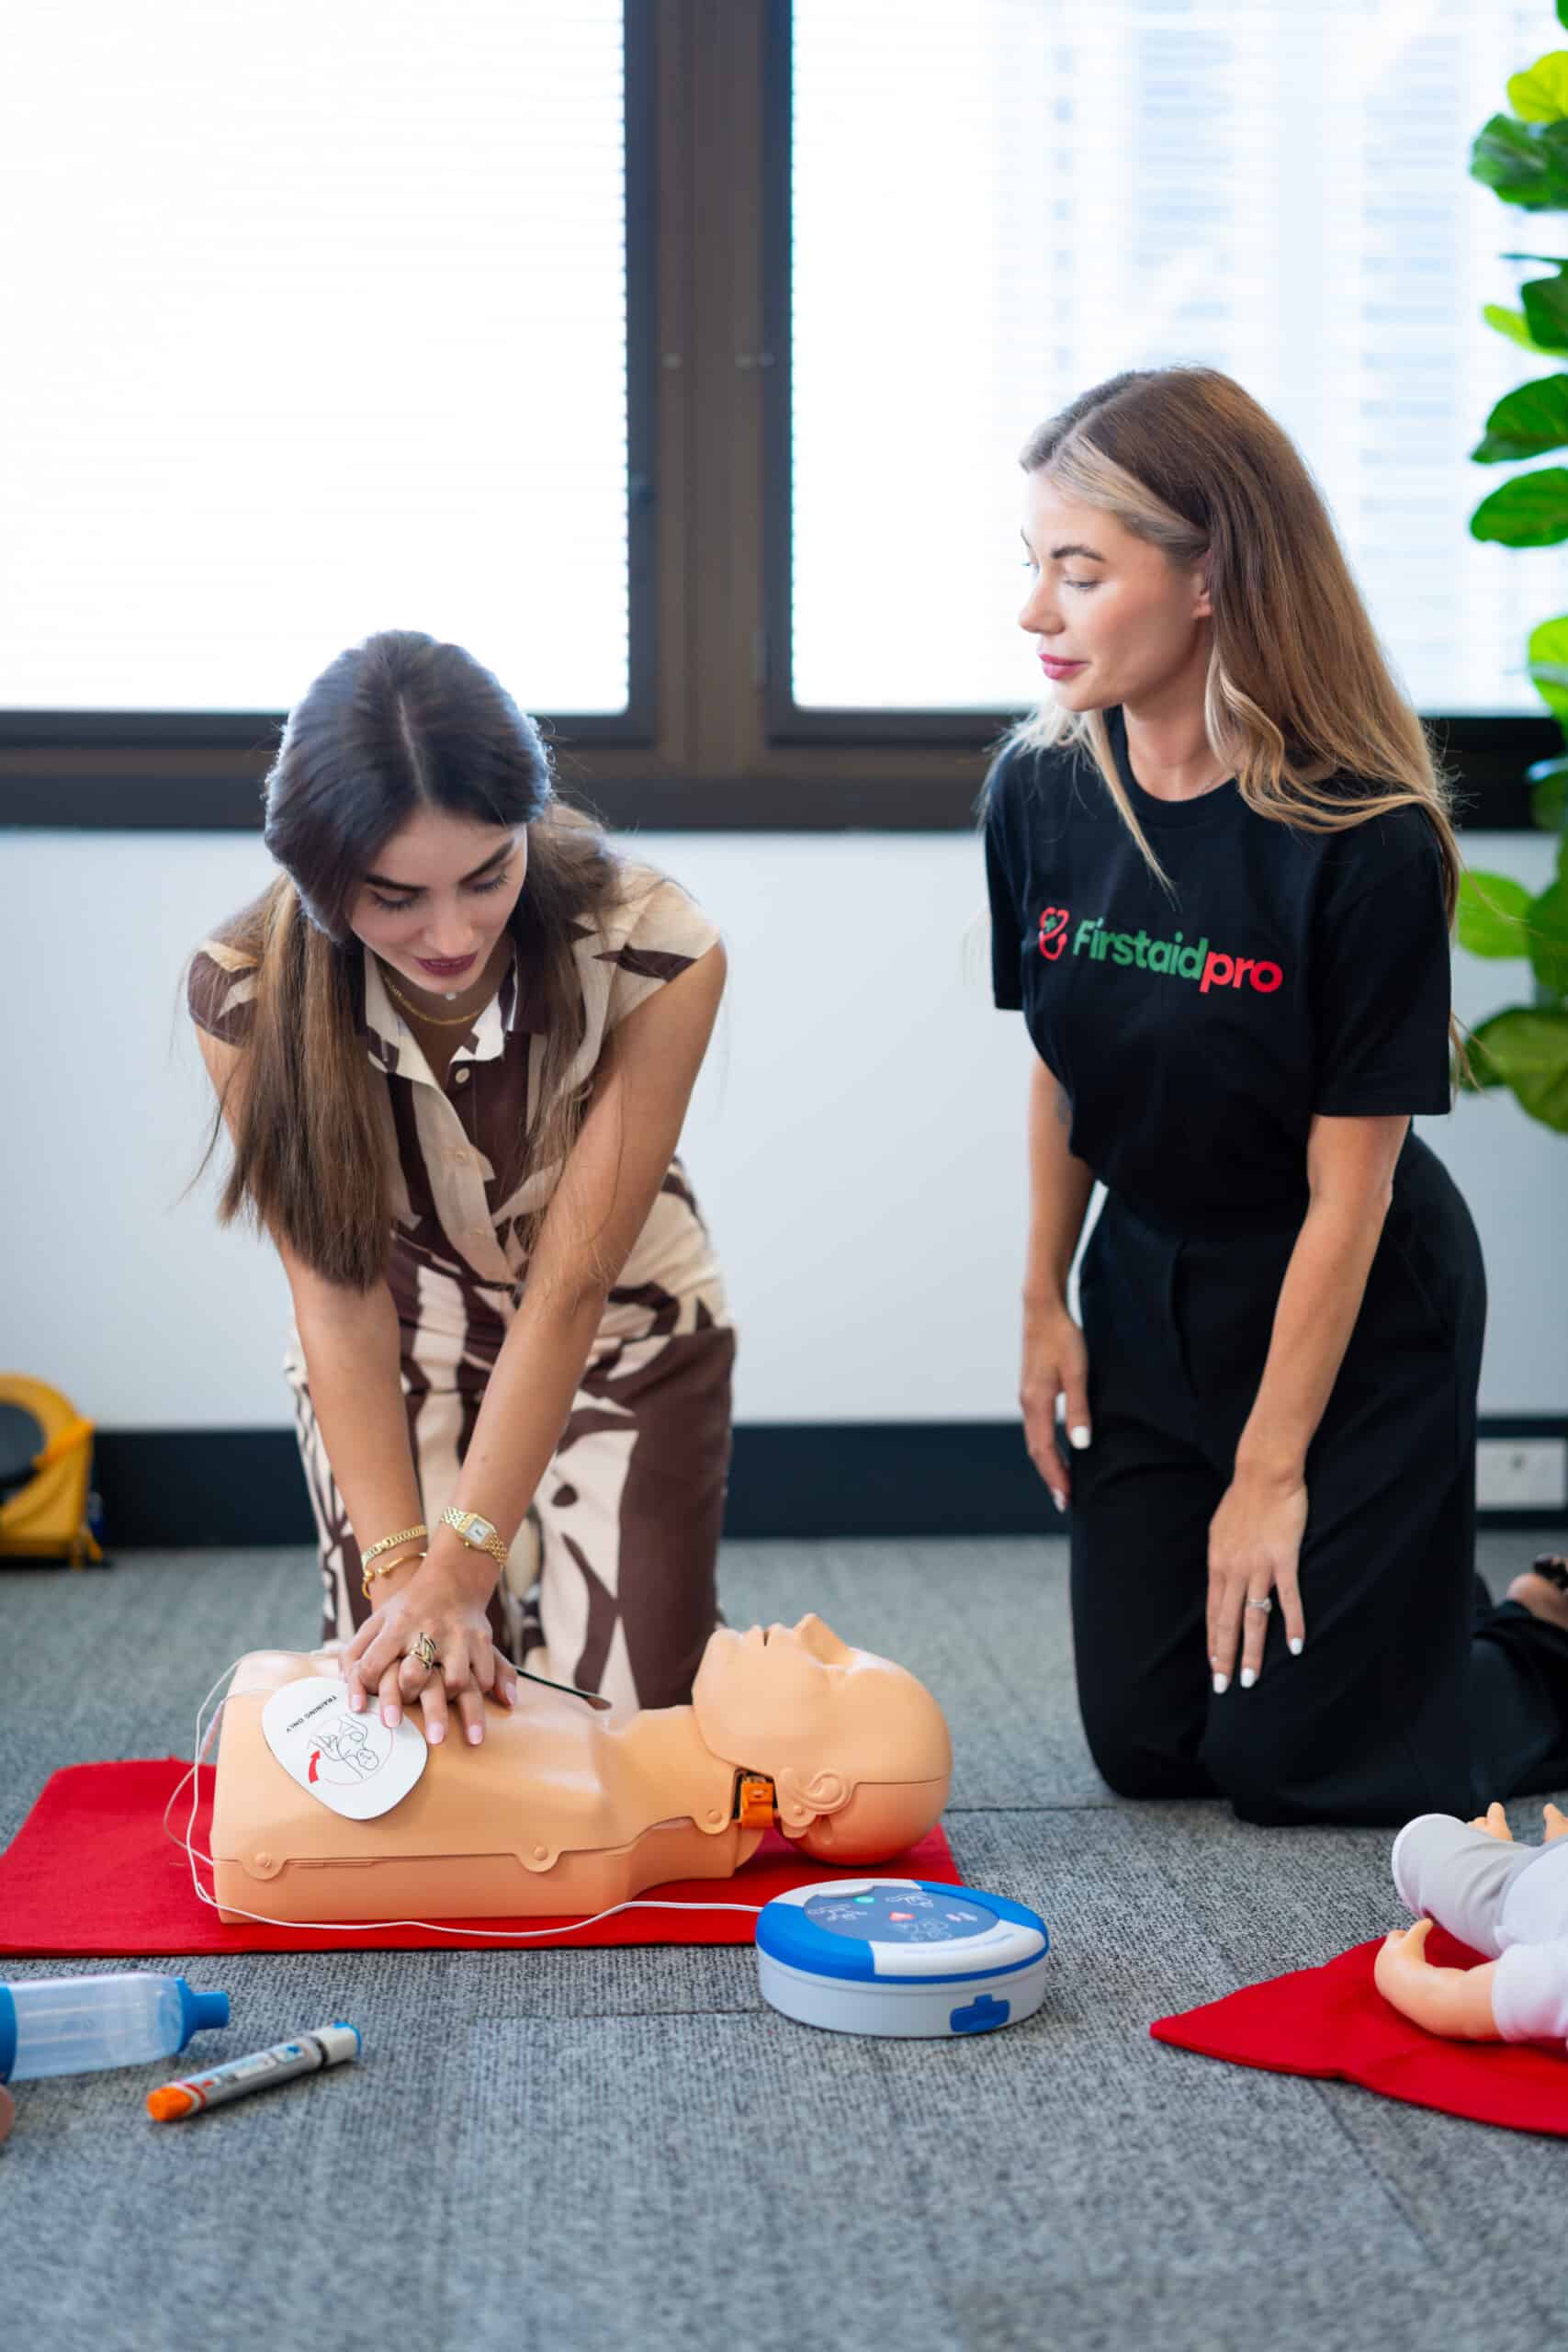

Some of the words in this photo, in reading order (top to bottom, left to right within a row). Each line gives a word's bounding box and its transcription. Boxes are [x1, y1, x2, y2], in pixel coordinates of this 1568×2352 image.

[1072, 917, 1283, 993] Firstaidpro
[304, 1695, 338, 1719] TRAINING
[286, 1718, 304, 1734] ONLY
